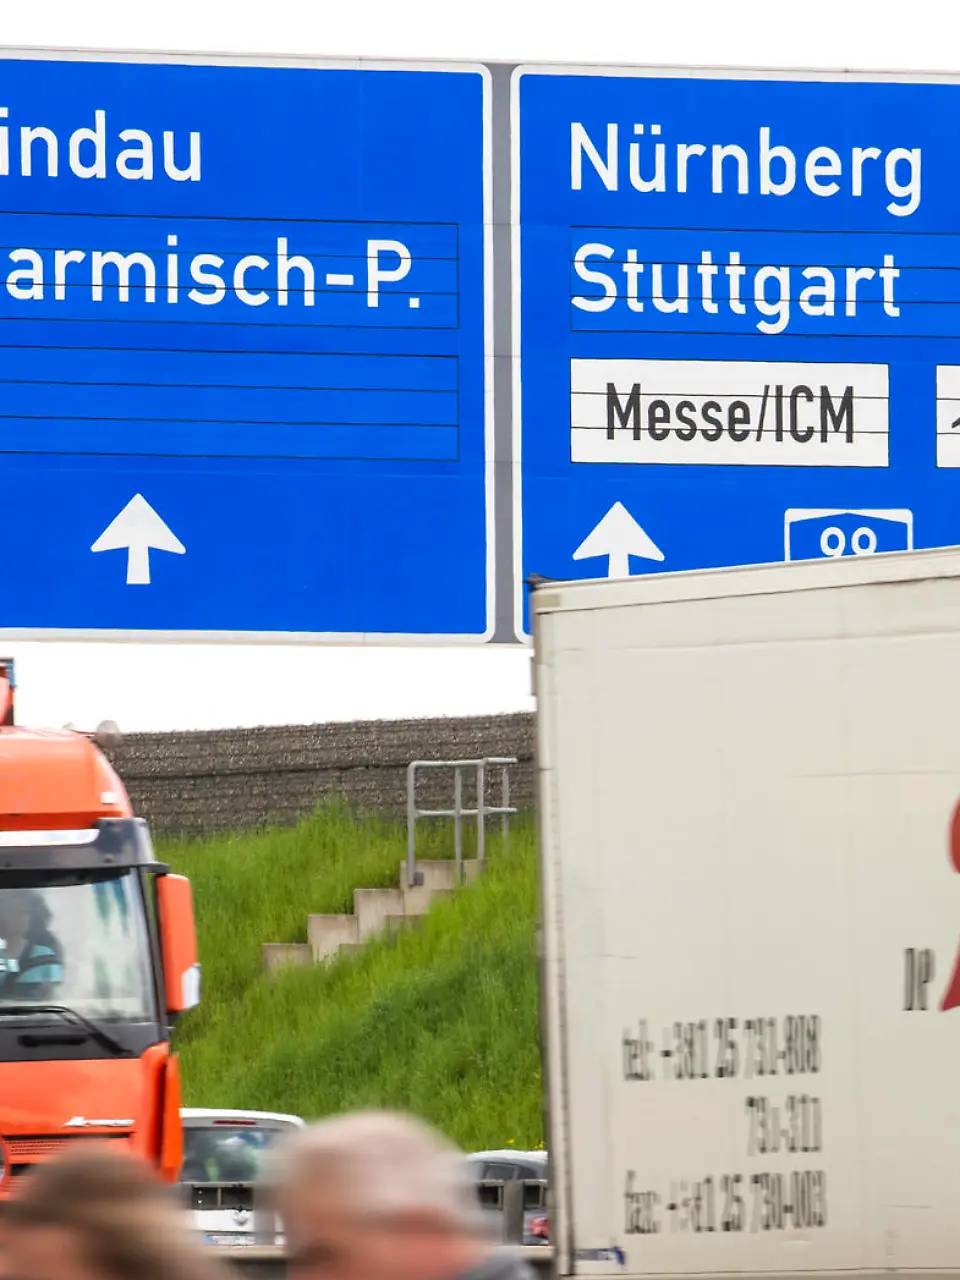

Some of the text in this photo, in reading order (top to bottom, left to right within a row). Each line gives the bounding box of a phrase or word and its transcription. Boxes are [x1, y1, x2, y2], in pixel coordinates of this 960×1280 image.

[570, 122, 922, 217] Nürnberg
[6, 234, 420, 309] armisch-P.
[570, 242, 900, 335] Stuttgart
[606, 382, 854, 444] Messe/ICM
[713, 1017, 739, 1079] 25
[720, 1173, 745, 1232] 25
